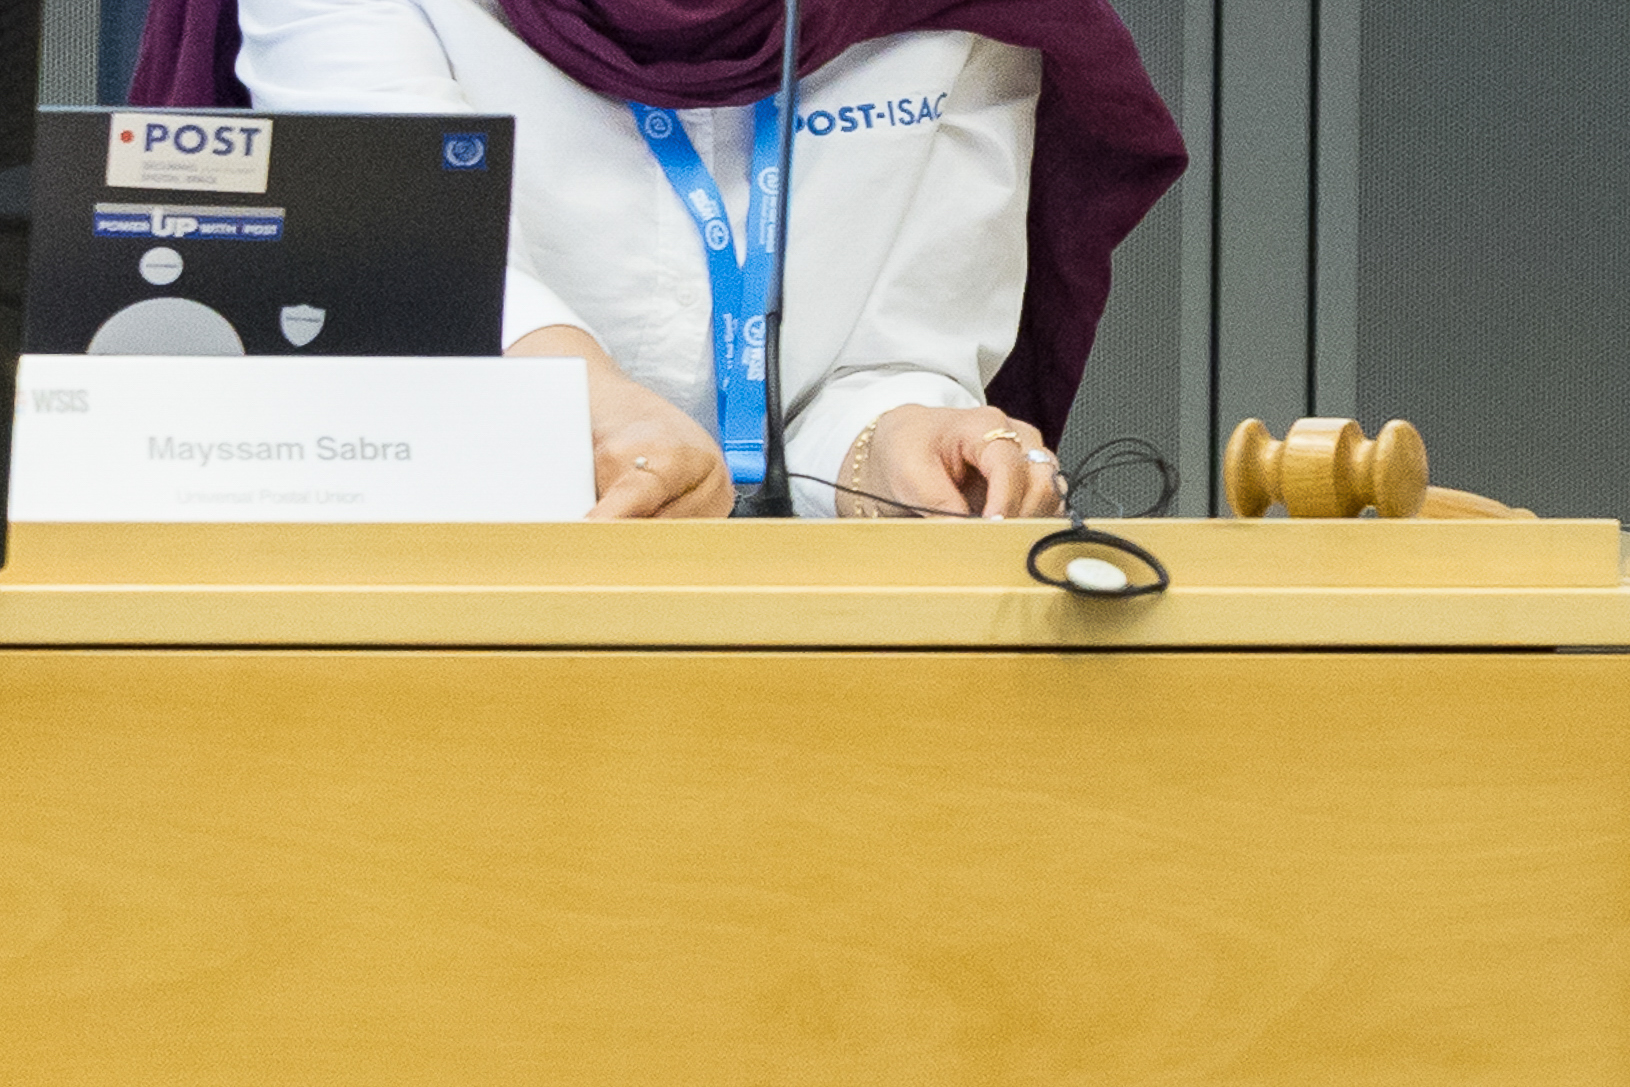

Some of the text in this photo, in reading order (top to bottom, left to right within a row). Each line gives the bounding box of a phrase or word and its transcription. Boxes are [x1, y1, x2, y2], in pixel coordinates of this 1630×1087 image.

[143, 123, 262, 157] POST
[32, 389, 90, 413] WSIS
[148, 436, 412, 467] Mayssam Sabra
[177, 489, 364, 505] Universal Postal Union
